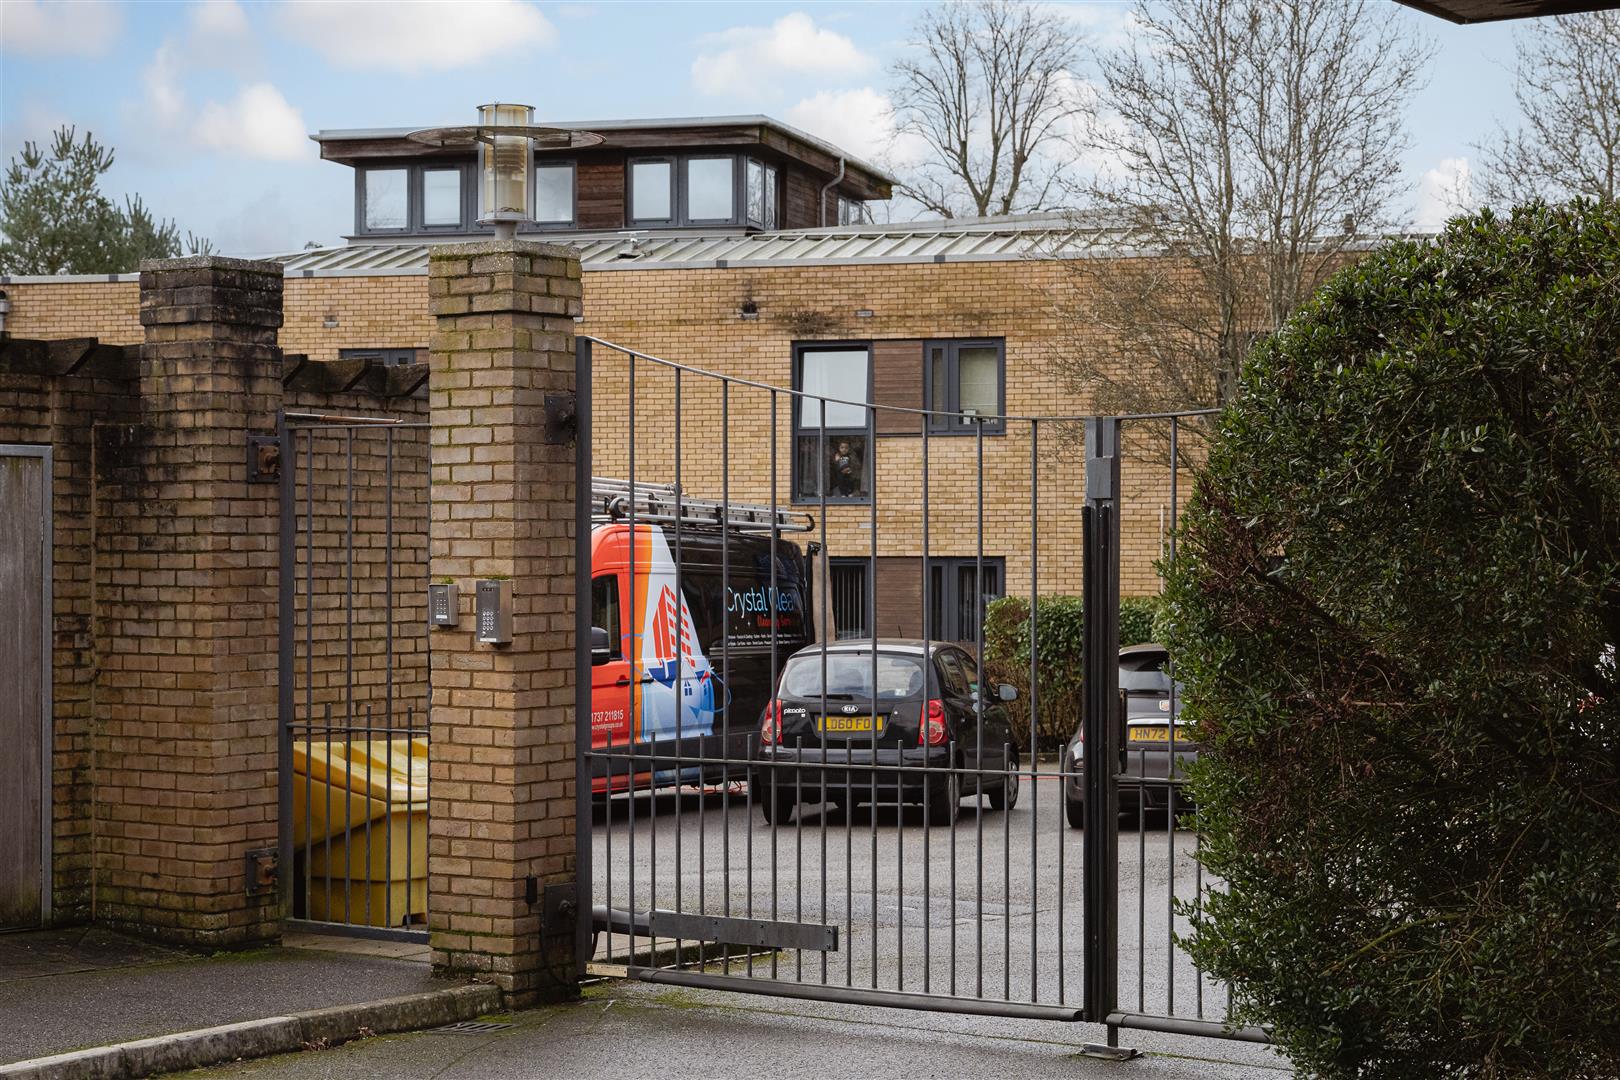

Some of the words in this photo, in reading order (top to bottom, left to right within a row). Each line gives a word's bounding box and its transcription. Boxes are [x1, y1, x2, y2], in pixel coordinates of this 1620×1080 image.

[604, 709, 624, 721] 211815
[826, 719, 852, 730] D60
[855, 718, 877, 729] FO
[1135, 728, 1166, 739] HN72
